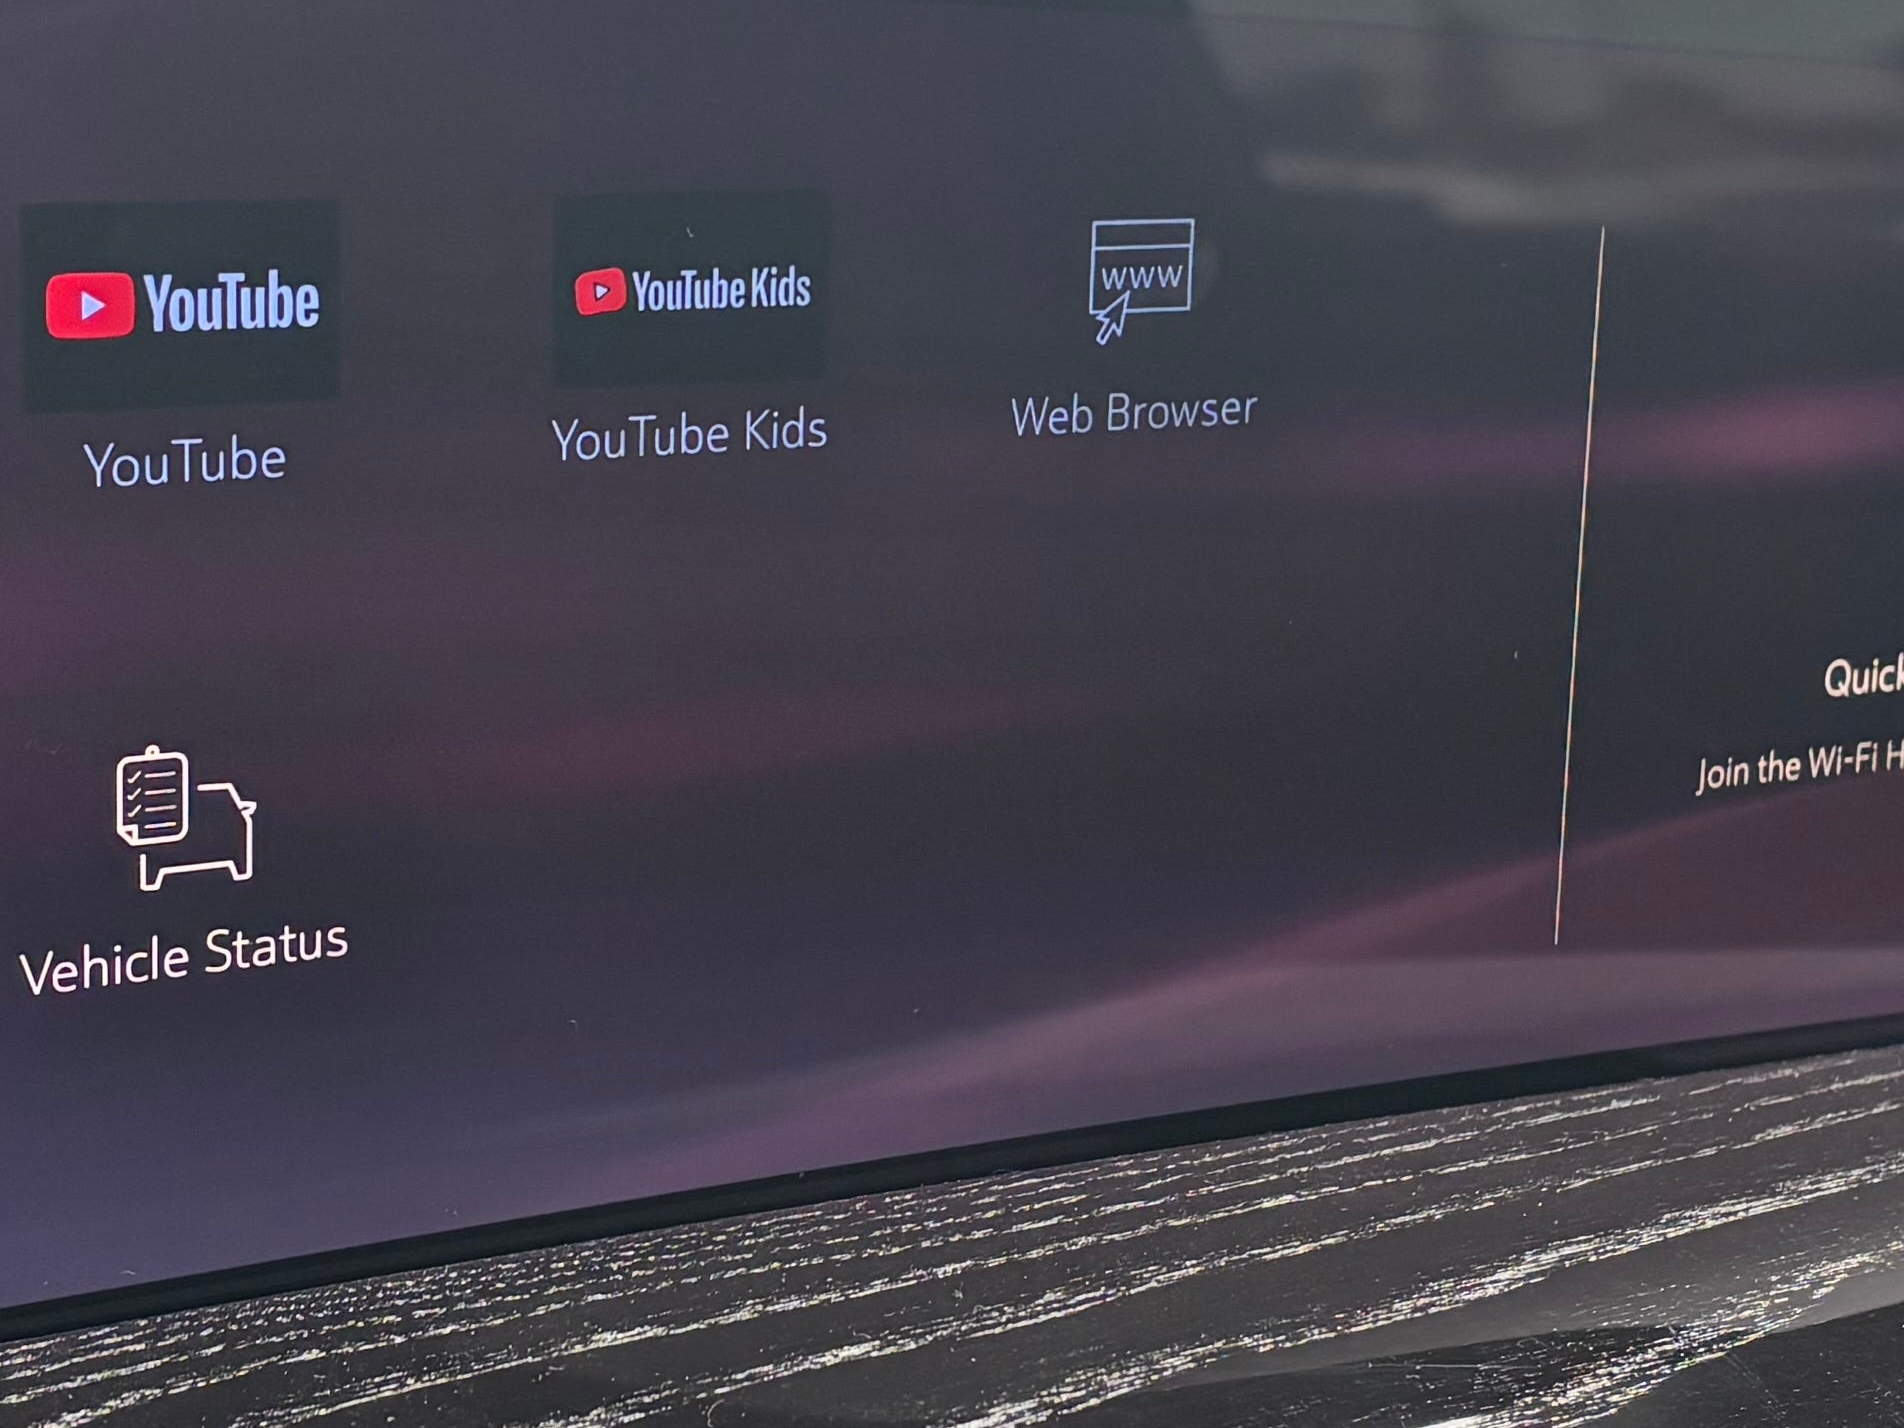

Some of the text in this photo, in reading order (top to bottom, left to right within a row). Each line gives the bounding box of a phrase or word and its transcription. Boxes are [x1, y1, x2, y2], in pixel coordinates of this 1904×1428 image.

[143, 268, 321, 333] YouTube
[632, 264, 811, 312] YouTube Kids
[551, 405, 828, 461] YouTube Kids
[1011, 392, 1259, 437] Web Browser
[82, 433, 287, 488] YouTube
[1695, 757, 1751, 797] Join
[1756, 749, 1803, 784] the
[1807, 741, 1879, 778] Wi-Fi
[18, 925, 349, 996] Vehicle Status
